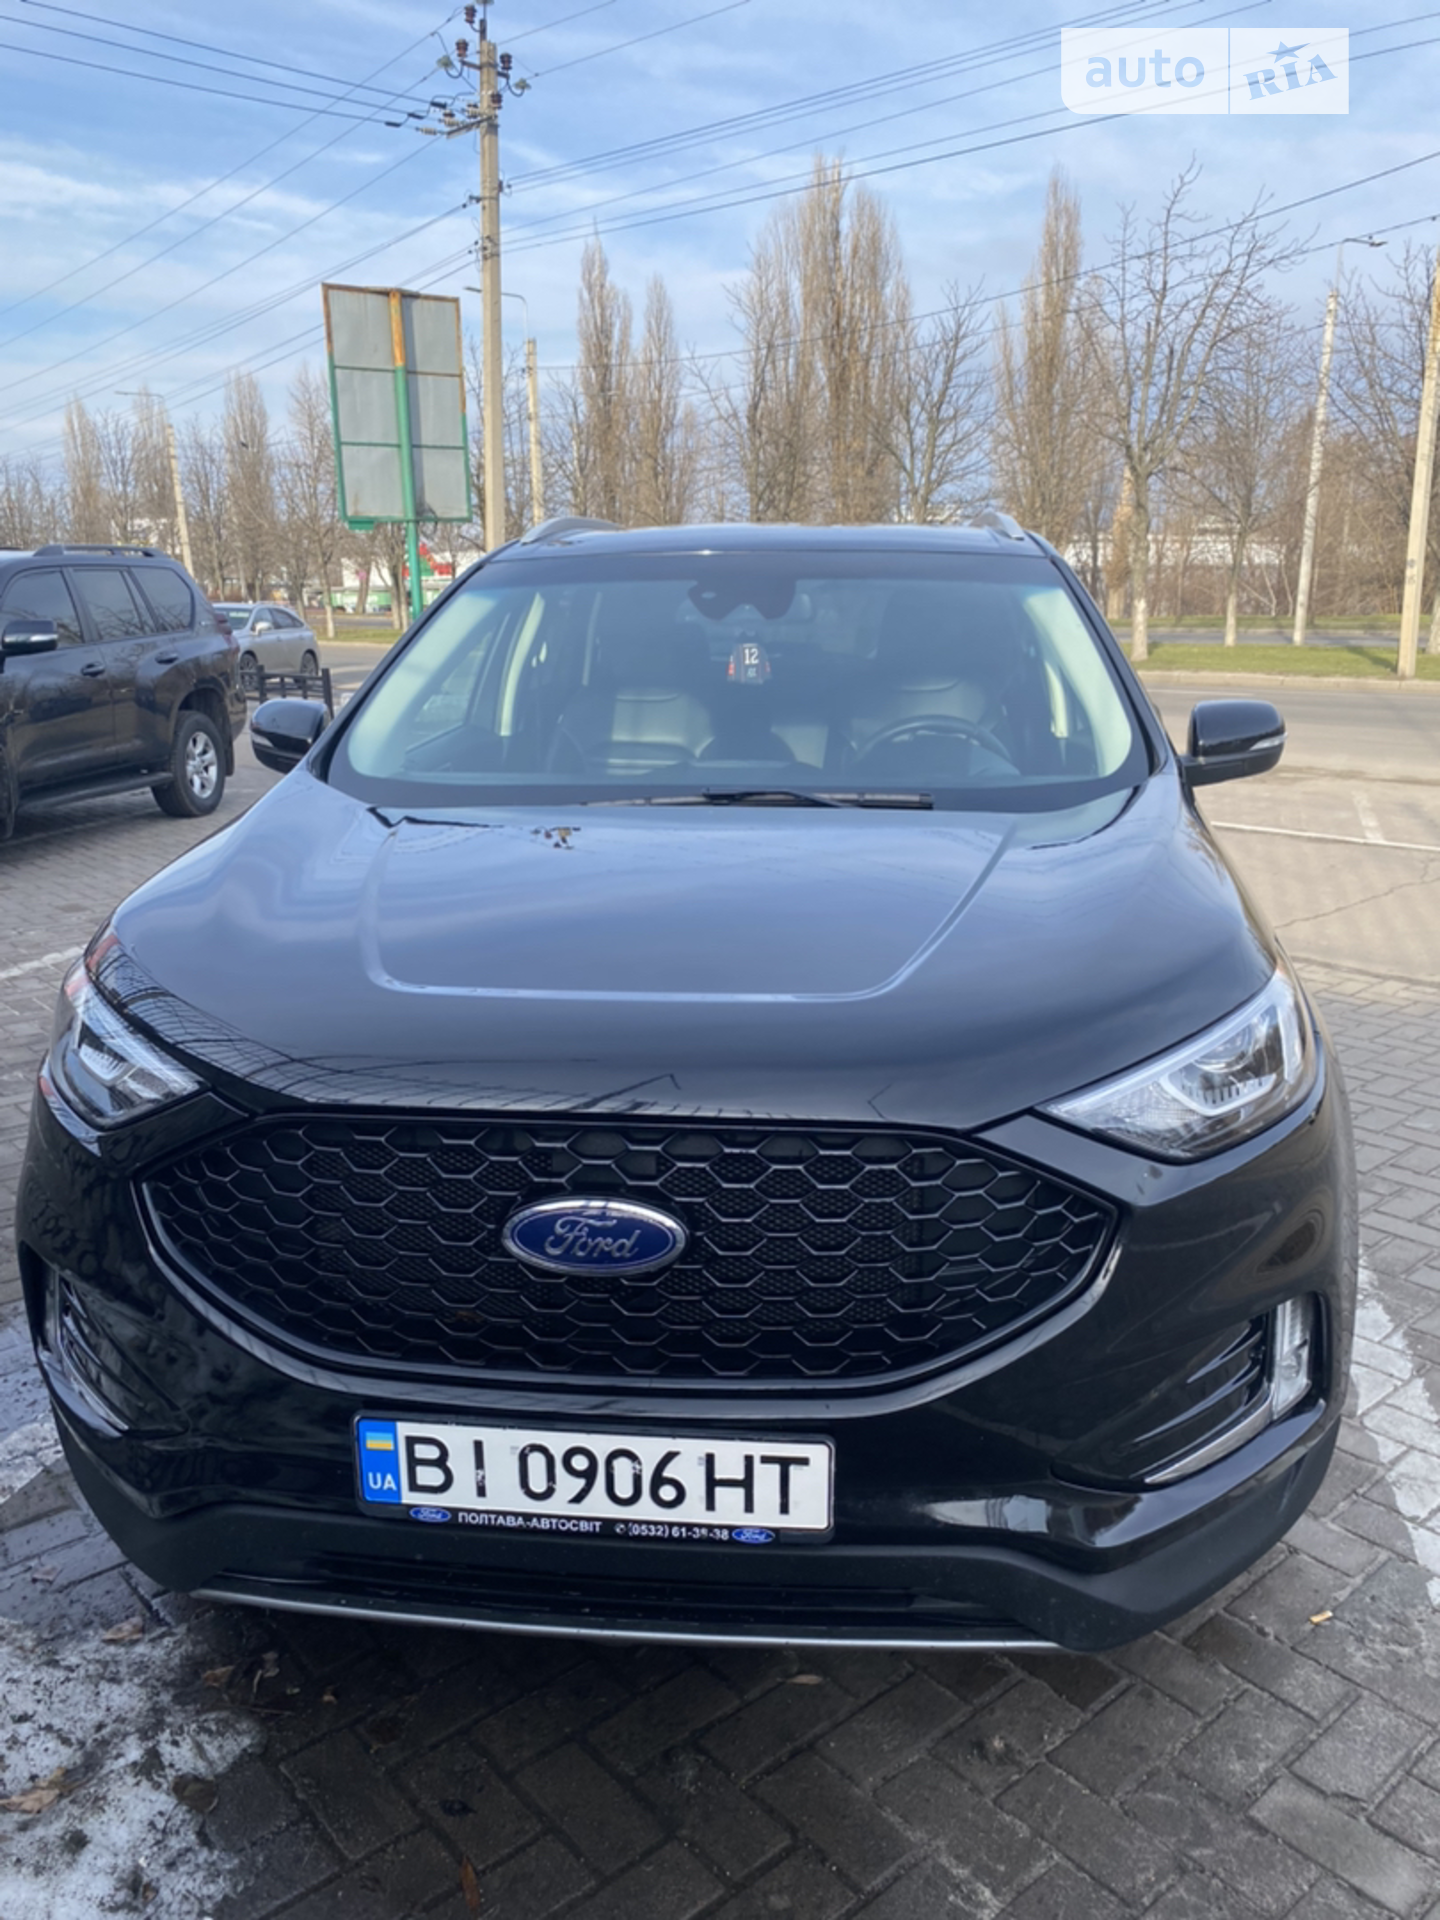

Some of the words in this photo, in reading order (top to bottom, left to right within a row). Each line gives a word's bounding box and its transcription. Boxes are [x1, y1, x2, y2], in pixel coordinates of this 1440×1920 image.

[744, 648, 760, 665] 12
[544, 1216, 642, 1258] Ford
[367, 1472, 398, 1491] UA
[404, 1435, 487, 1498] BI
[518, 1443, 687, 1510] 0906
[705, 1453, 811, 1515] HT
[458, 1511, 603, 1532] ПОЛТАВА-АВТОСВІТ
[628, 1522, 670, 1539] (0532)
